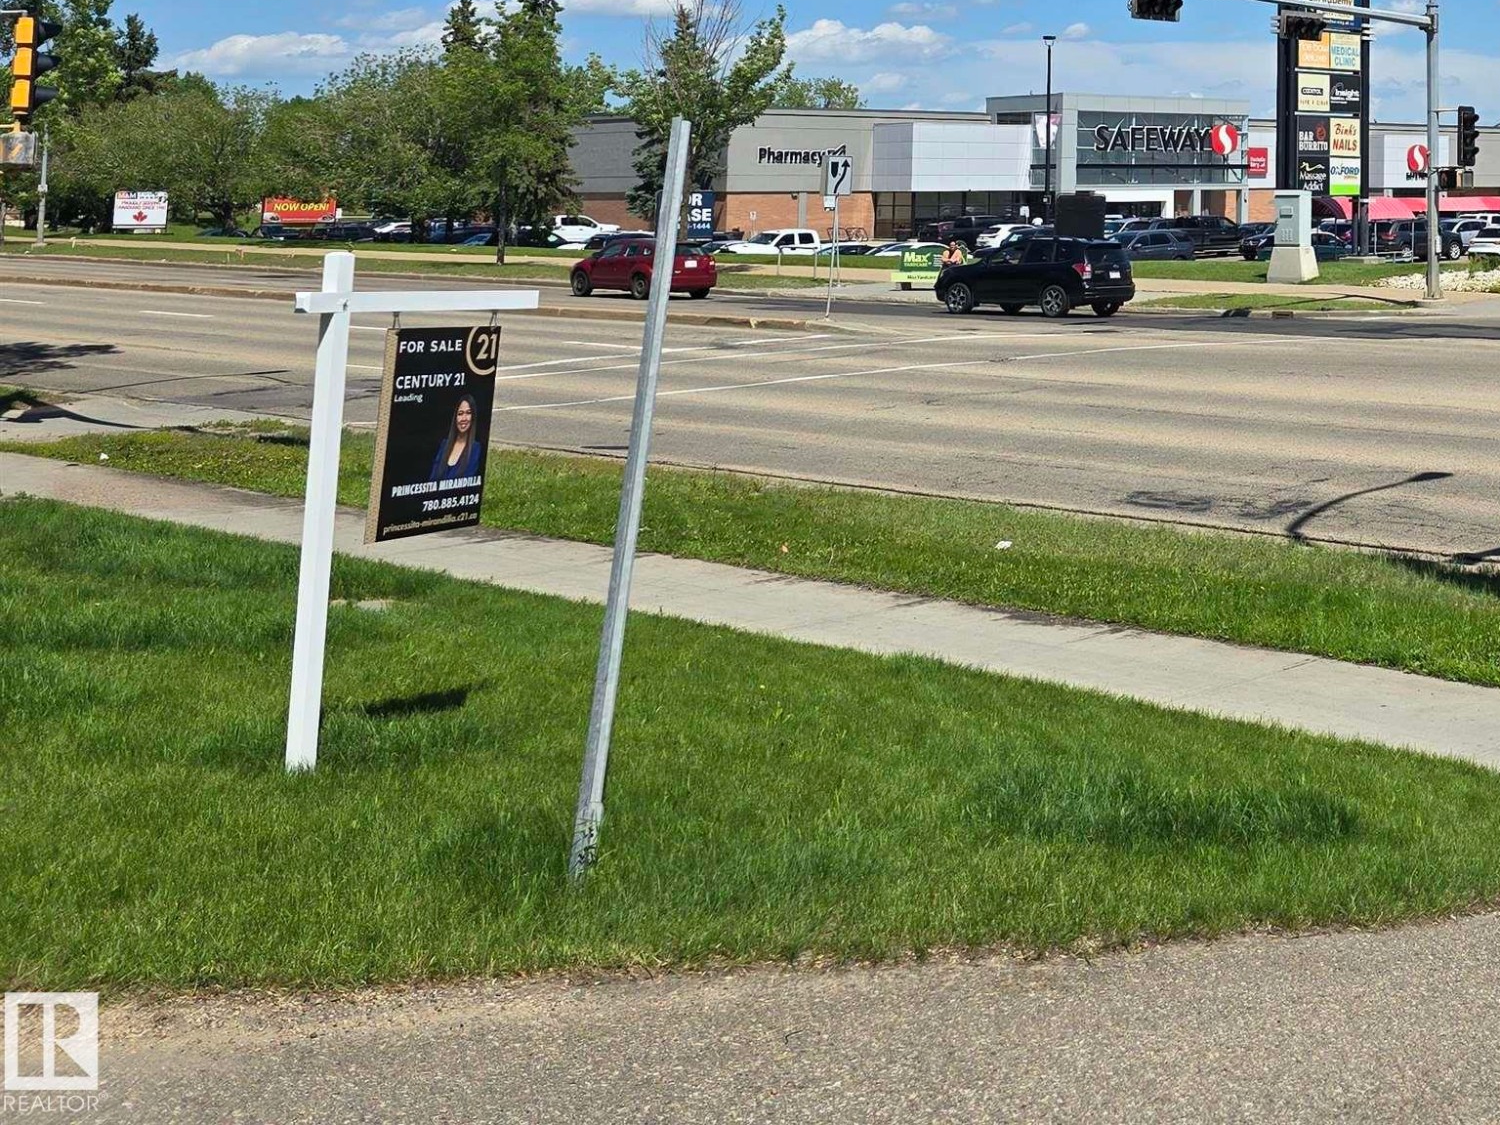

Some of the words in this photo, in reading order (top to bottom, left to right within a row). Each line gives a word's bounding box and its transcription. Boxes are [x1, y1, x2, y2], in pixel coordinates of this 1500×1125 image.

[1331, 45, 1360, 57] MEDICAL
[1334, 56, 1357, 67] CLINIC
[1094, 124, 1211, 154] SAFEWAY
[1298, 131, 1314, 141] BAR
[1298, 141, 1329, 151] BURRITO
[1332, 138, 1358, 152] NAILS
[758, 146, 826, 168] Pharmacy
[1299, 170, 1327, 183] Massage
[1303, 180, 1324, 191] Addict
[273, 202, 299, 211] NOW
[300, 202, 330, 212] OPEN!
[903, 251, 931, 263] Max
[399, 340, 425, 354] FOR
[430, 339, 463, 353] SALE
[395, 373, 453, 390] CENTURY
[454, 372, 466, 386] 21
[394, 392, 424, 403] Leading
[391, 481, 438, 498] PRINCESSITA
[438, 475, 482, 491] MIRANDILLA
[421, 493, 480, 512] 780.885.4124
